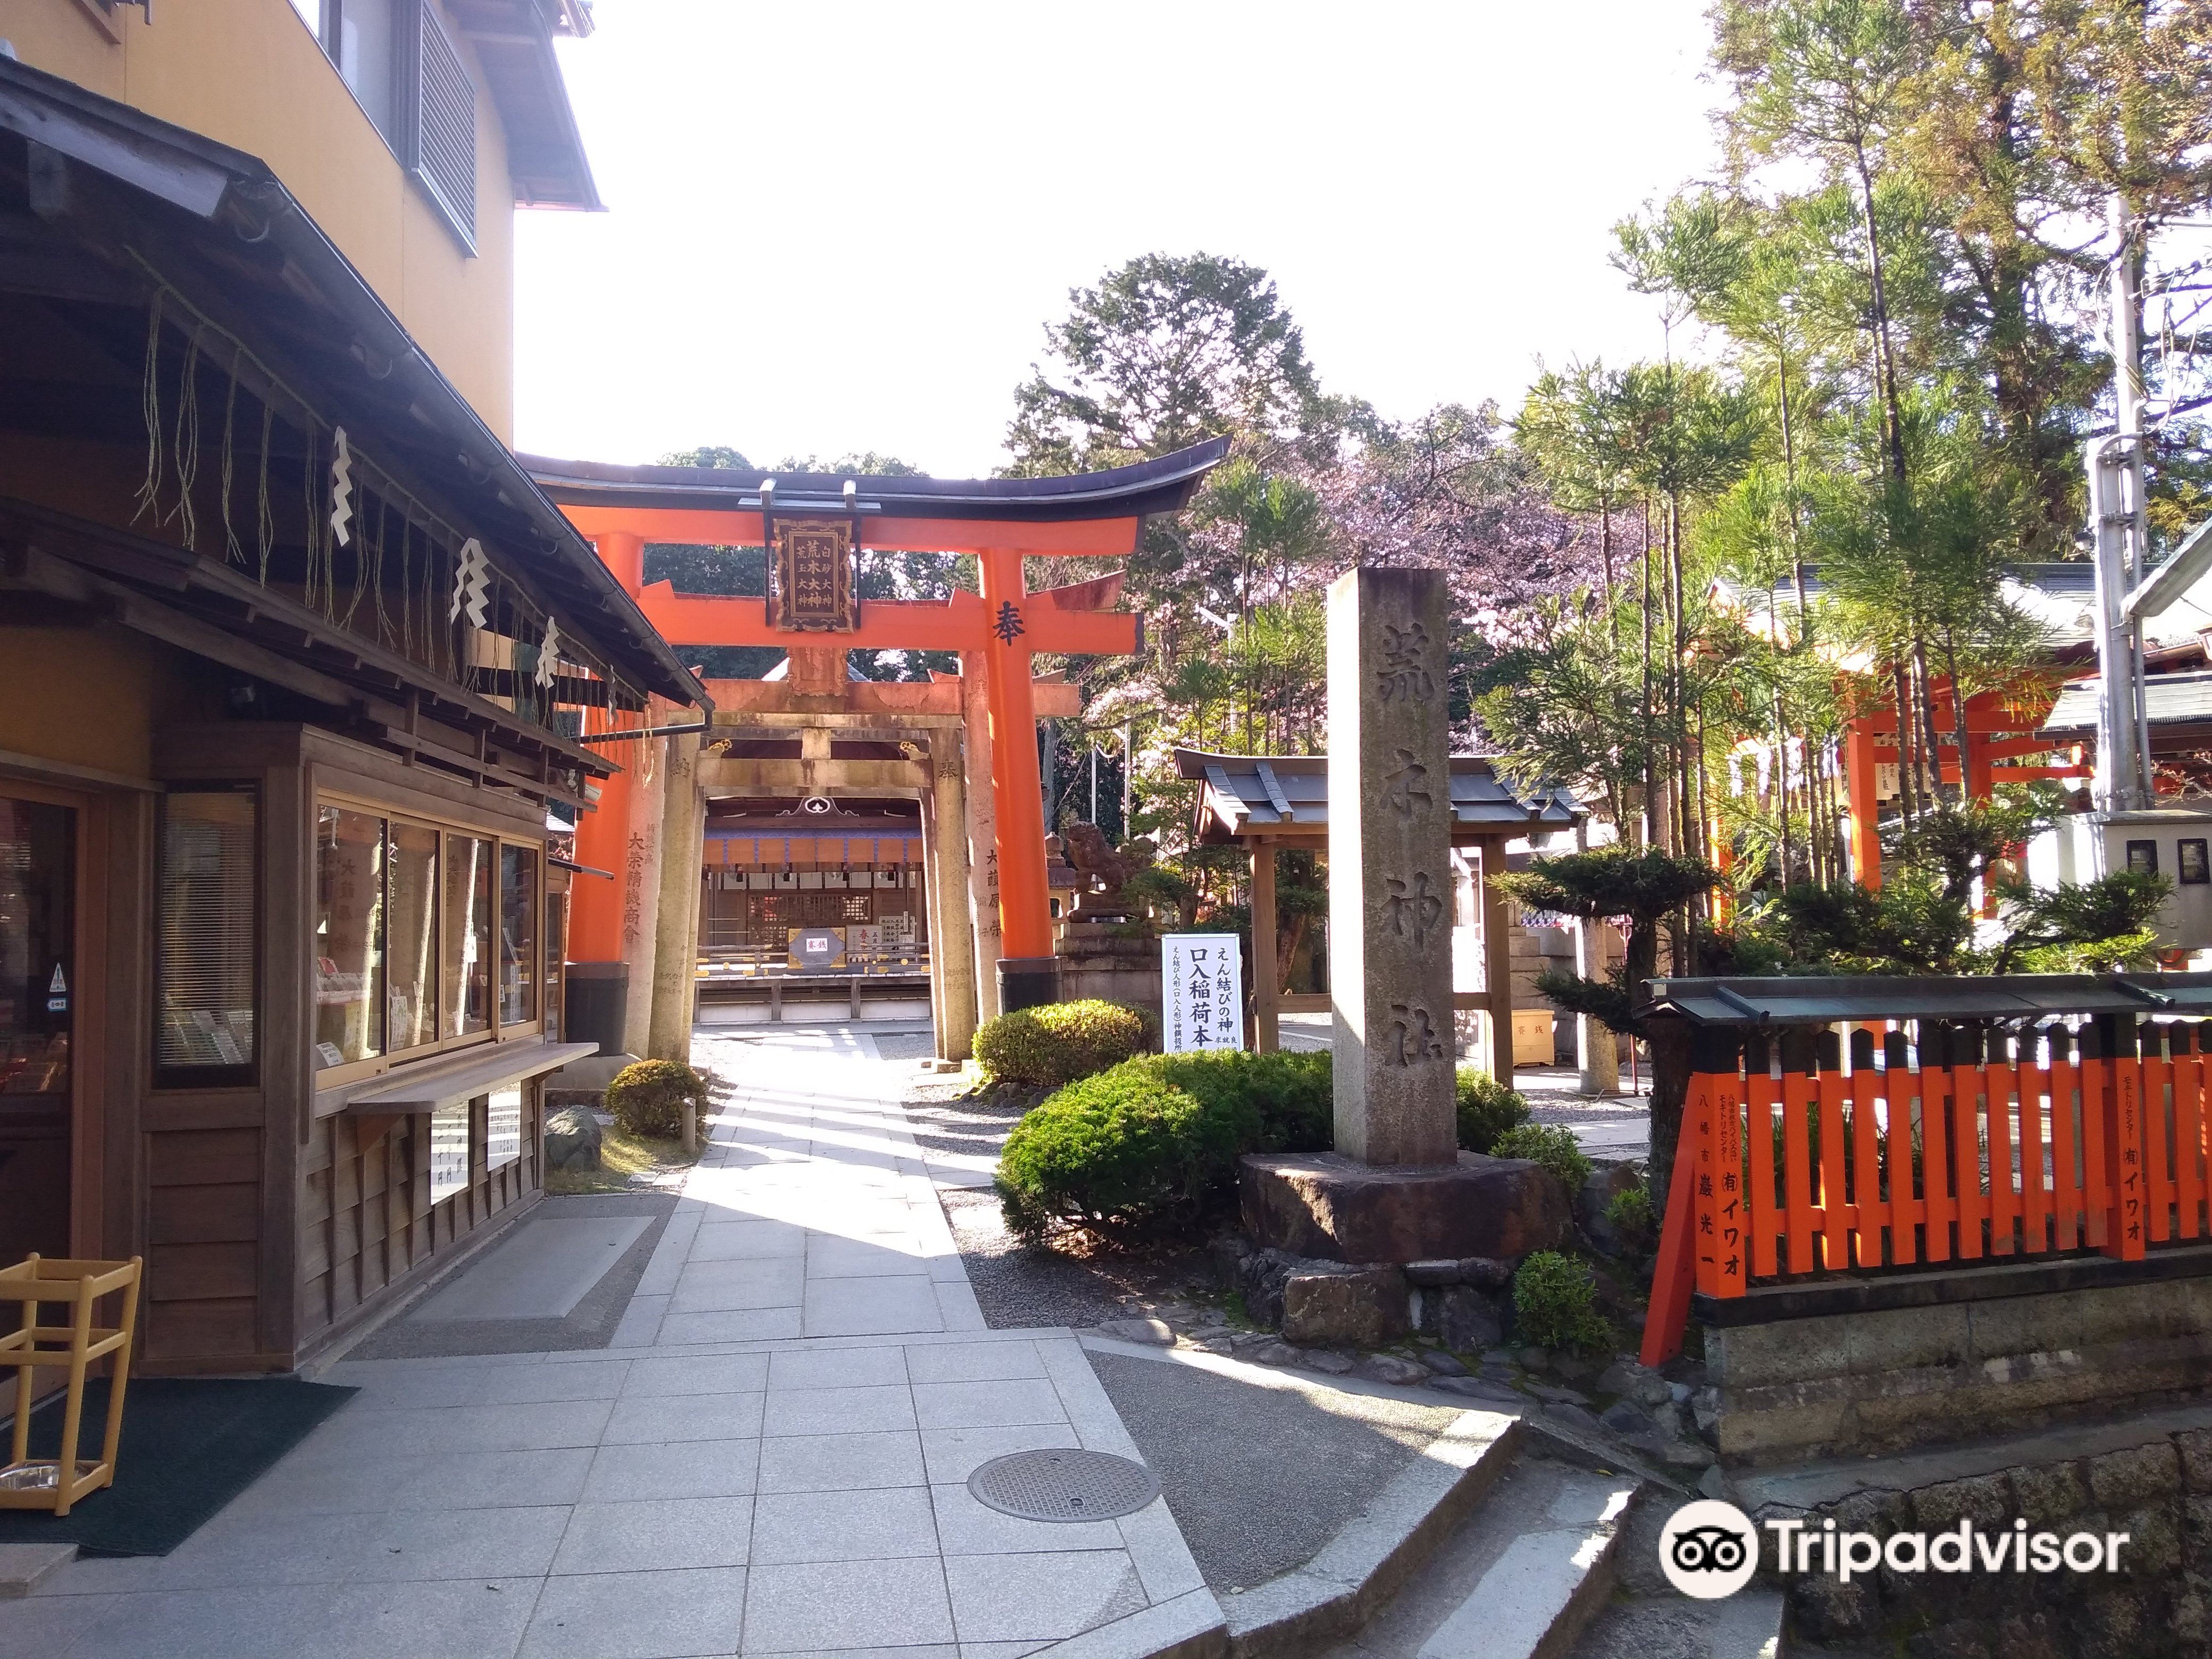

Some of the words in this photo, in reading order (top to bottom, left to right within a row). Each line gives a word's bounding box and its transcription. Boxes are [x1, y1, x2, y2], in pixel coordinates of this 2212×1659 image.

[806, 539, 822, 608] 荒木大神
[822, 546, 832, 607] 白砂大神
[993, 600, 1026, 647] 奉
[1378, 622, 1442, 1067] 荒木神社
[1217, 947, 1233, 1033] えん結びの神
